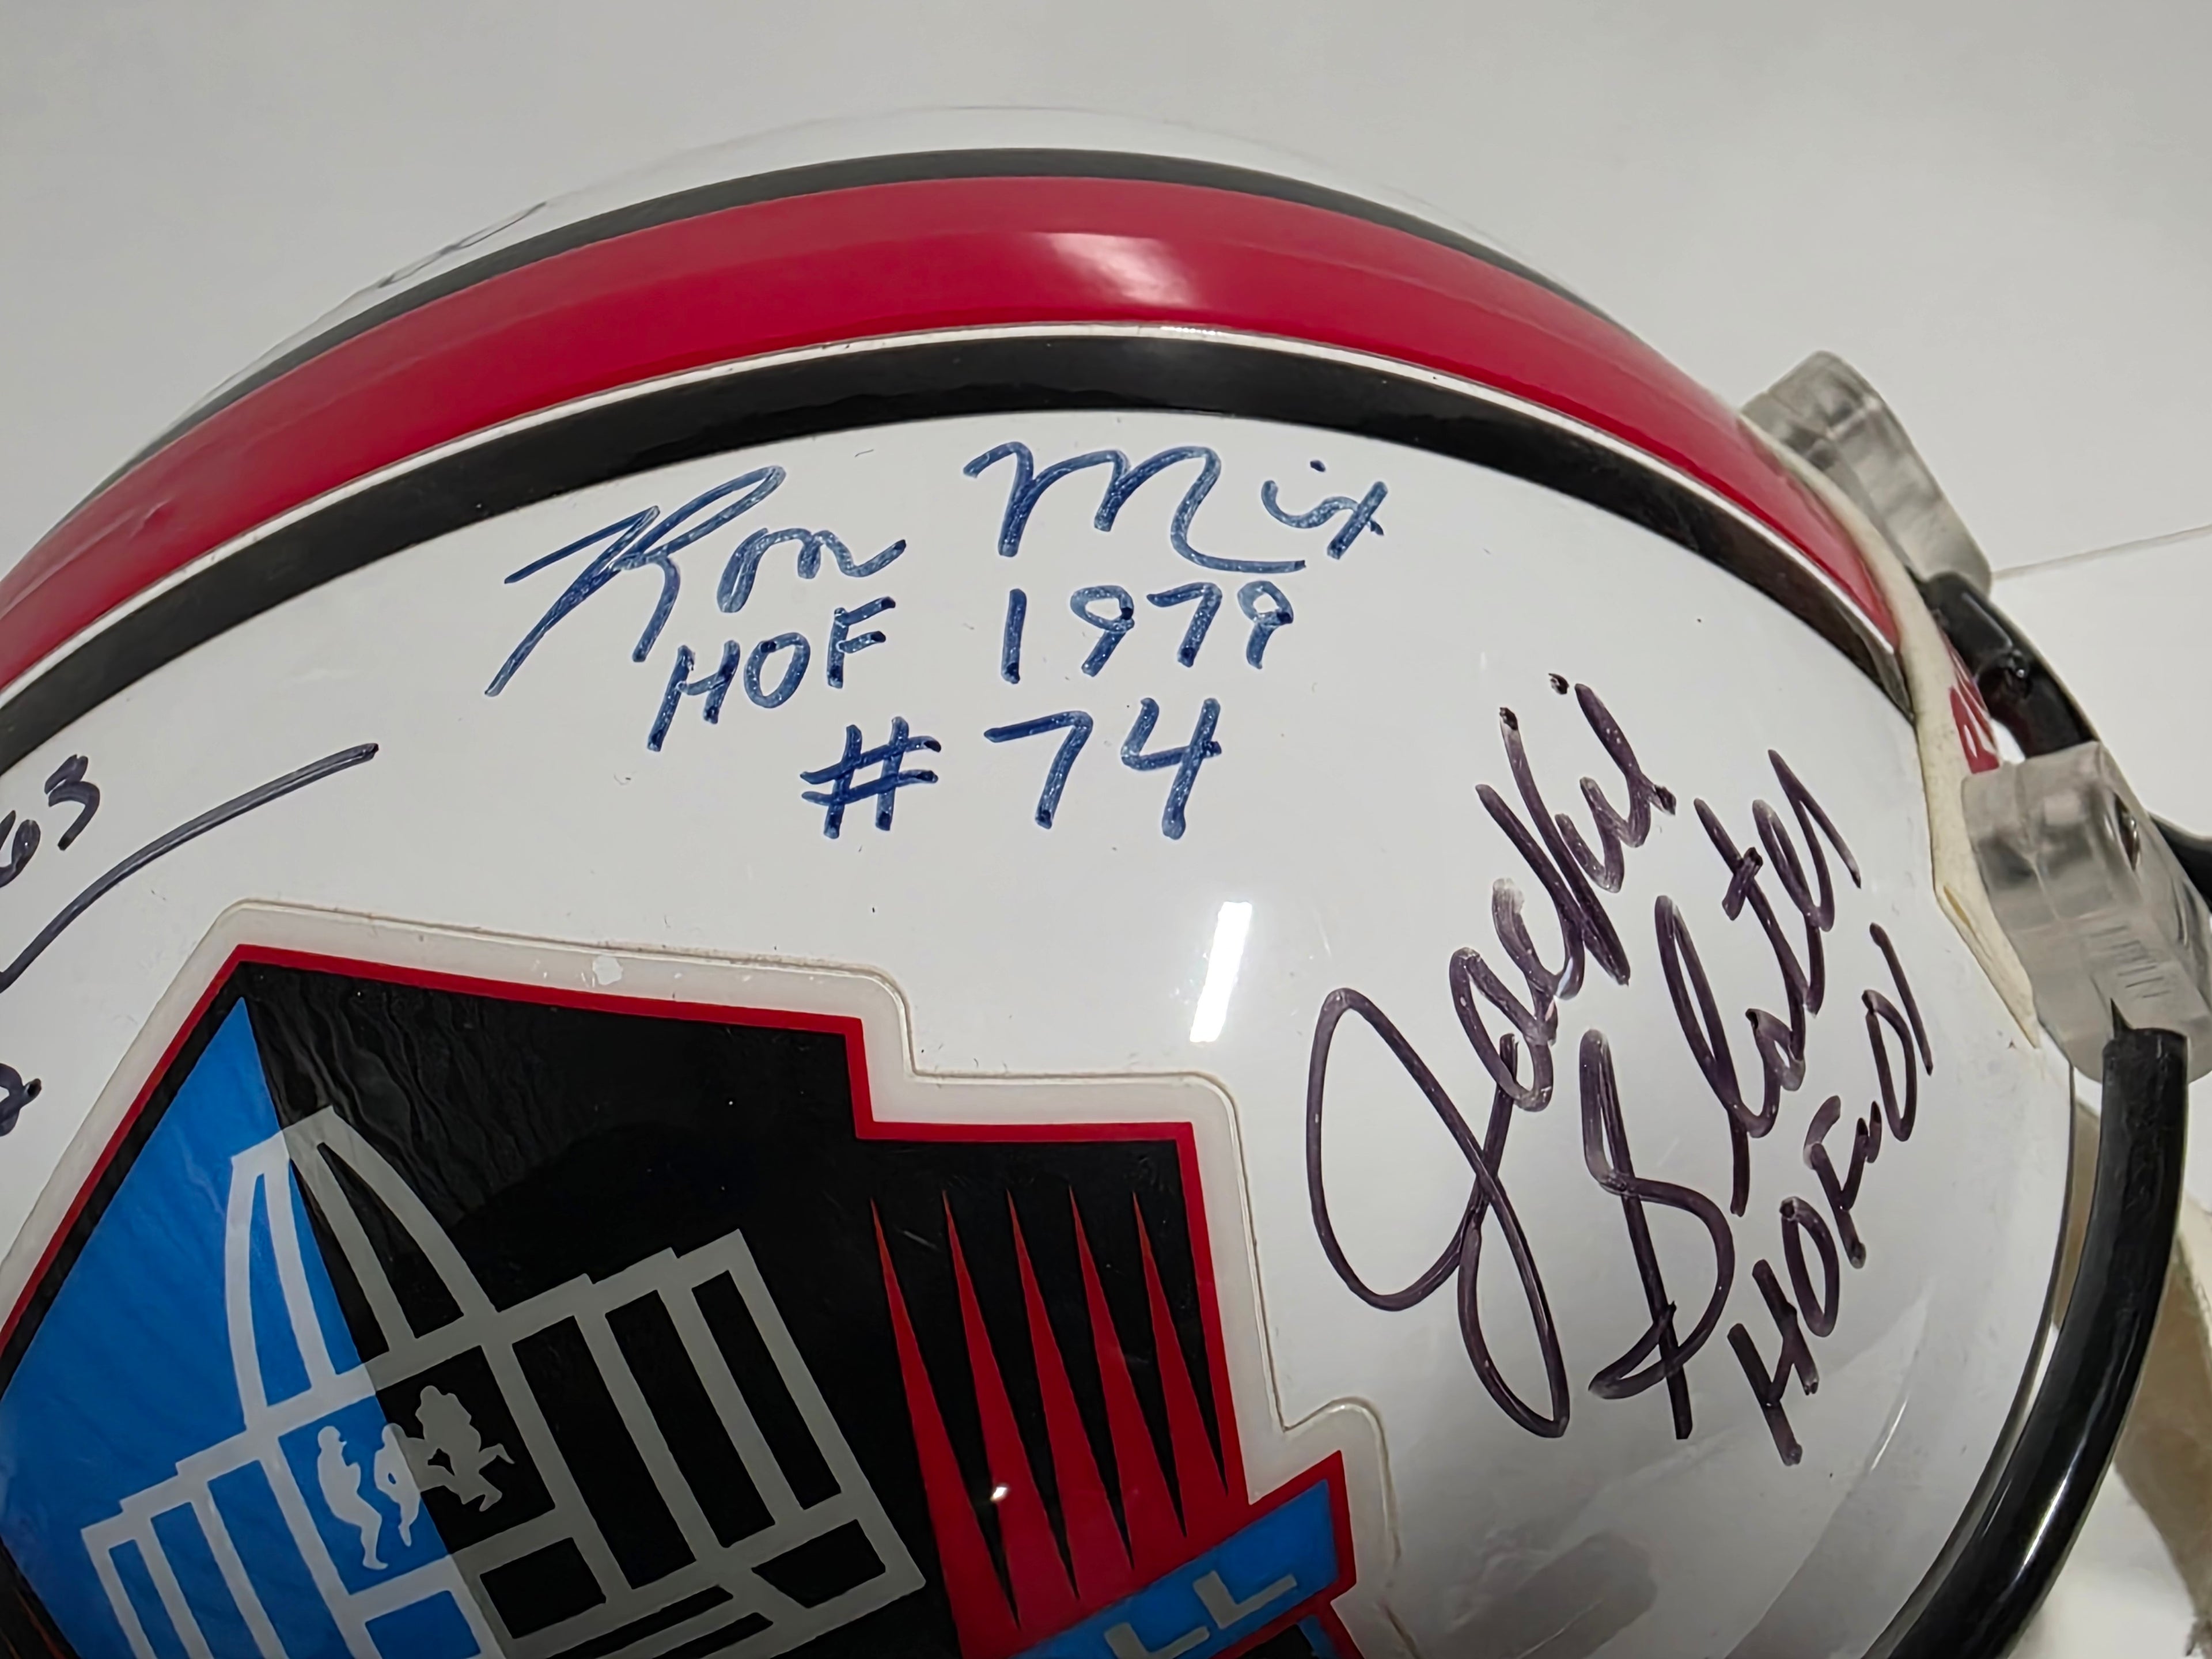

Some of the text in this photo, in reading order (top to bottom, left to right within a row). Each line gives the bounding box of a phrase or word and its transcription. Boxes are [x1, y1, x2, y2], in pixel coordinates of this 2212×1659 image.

[964, 441, 1388, 573] Mix
[648, 580, 1294, 751] HOF 1979
